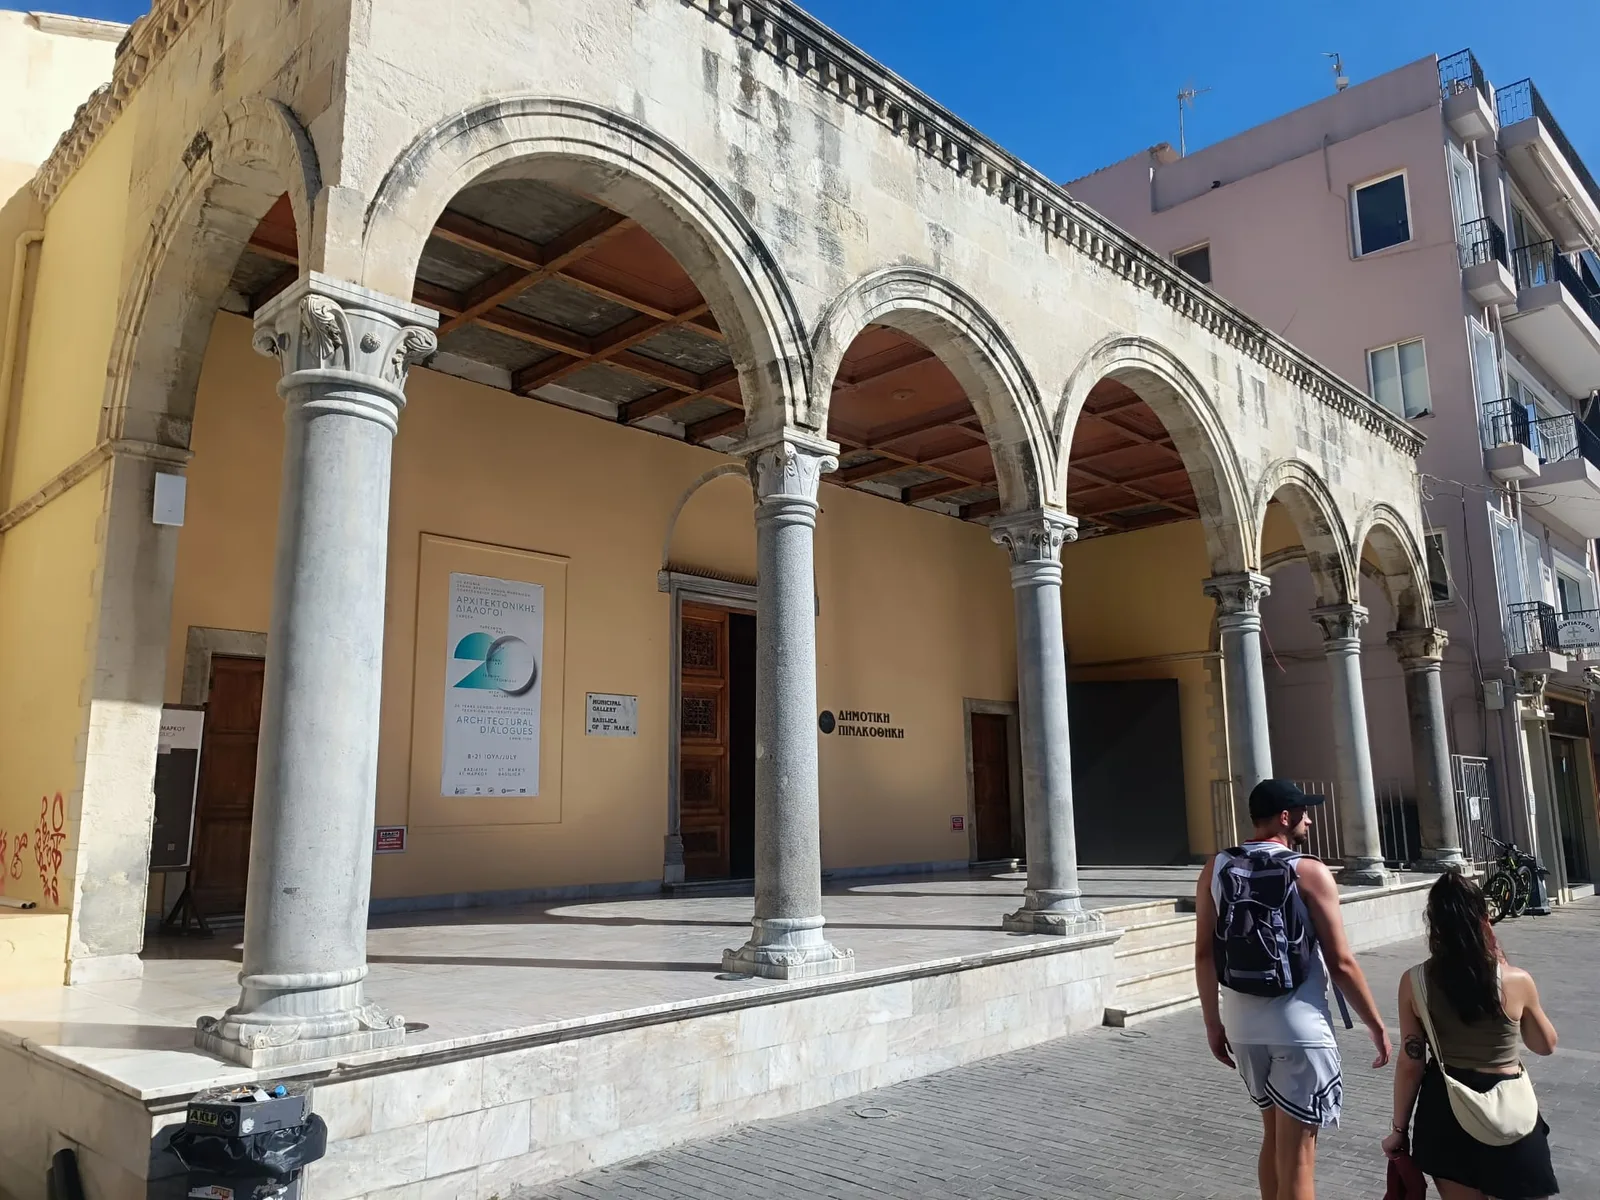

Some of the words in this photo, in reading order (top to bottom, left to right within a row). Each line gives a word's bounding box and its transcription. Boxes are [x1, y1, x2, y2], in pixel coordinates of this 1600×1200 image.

[456, 595, 536, 613] ΑΡΧΙΤΕΚΤΟΝΙΚΗΣ
[456, 604, 503, 617] ΔΙΑΛΟΓΟΙ
[456, 715, 533, 727] ARCHITECTURAL
[838, 710, 890, 723] ΔΗΜΟΤΙΚΗ
[480, 726, 533, 736] DIALOGUES
[838, 725, 904, 738] ΠΙΝΑΚΟΘΗΚΗ
